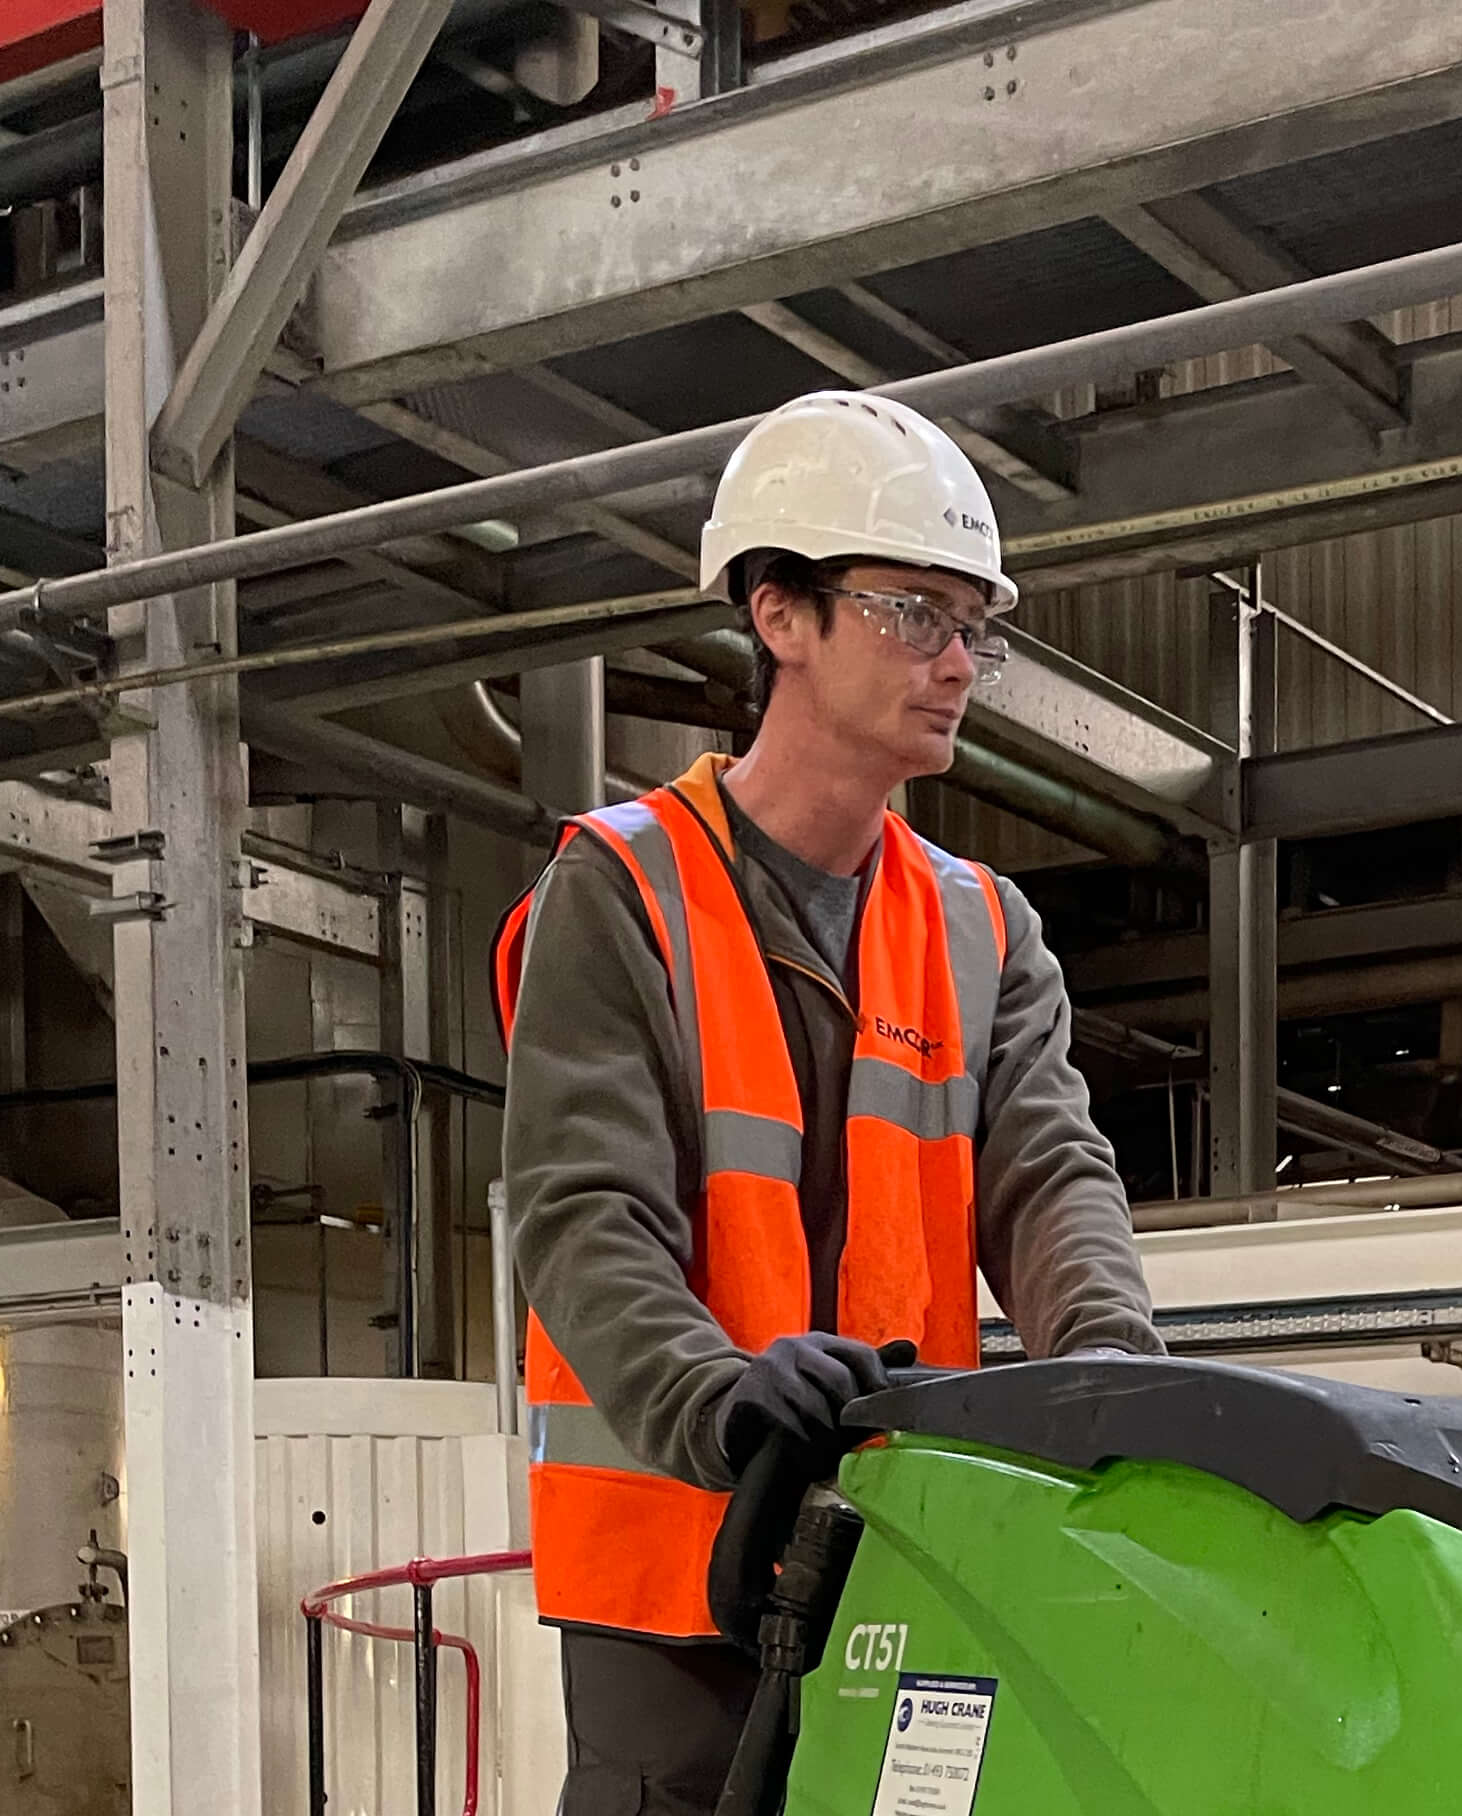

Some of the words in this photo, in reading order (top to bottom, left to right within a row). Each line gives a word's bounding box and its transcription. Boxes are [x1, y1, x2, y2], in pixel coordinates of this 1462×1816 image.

[845, 1623, 908, 1671] CT51
[921, 1699, 949, 1716] HUGH
[952, 1701, 986, 1719] CRANE
